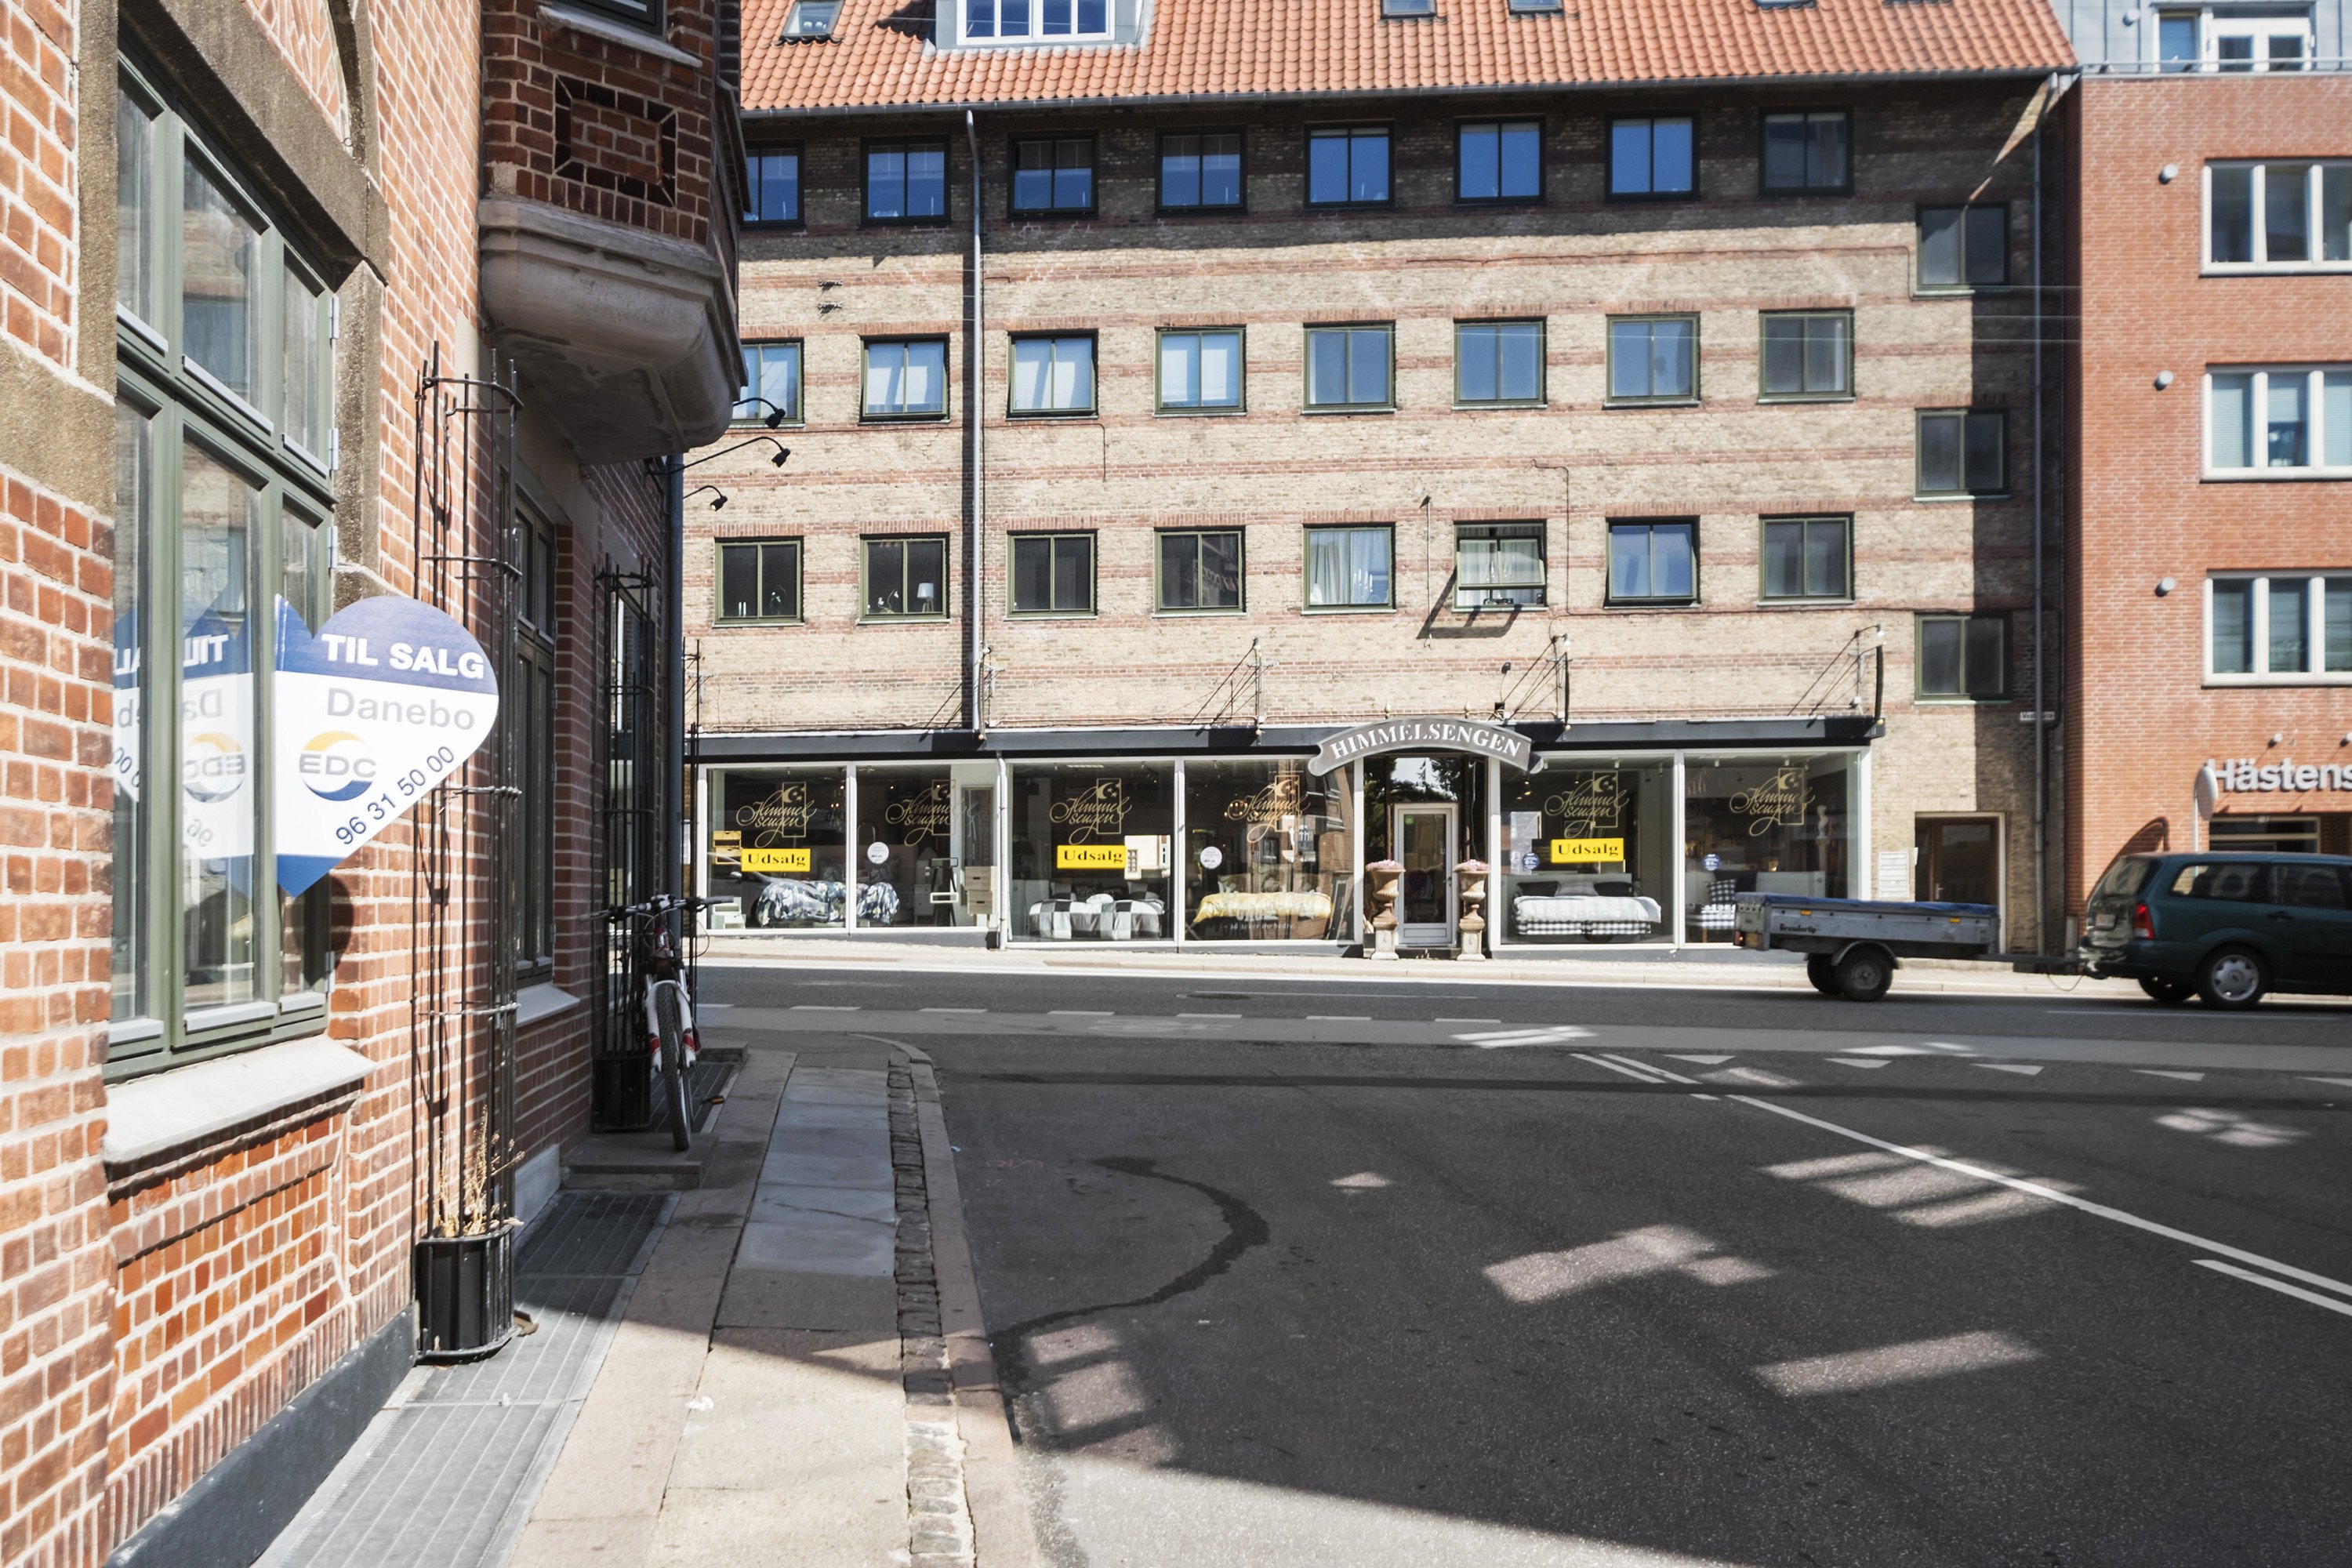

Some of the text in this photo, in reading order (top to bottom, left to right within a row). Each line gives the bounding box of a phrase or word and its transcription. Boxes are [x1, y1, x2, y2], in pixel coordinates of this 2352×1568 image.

[321, 633, 485, 679] TIL SALG
[327, 687, 474, 730] Danebo
[1330, 723, 1522, 760] HIMMELSENGEN
[299, 753, 377, 778] EDC
[336, 746, 455, 845] 96 31 50 00
[736, 790, 817, 826] Himmel
[1050, 786, 1132, 823] Himmel
[1544, 779, 1629, 815] Himmel
[755, 816, 808, 848] sengen
[1069, 813, 1123, 845] sengen
[1565, 806, 1621, 839] sengen
[1749, 804, 1807, 837] sengen
[748, 854, 805, 866] Udsalg
[1064, 850, 1123, 863] Udsalg
[1558, 844, 1619, 856] Udsalg
